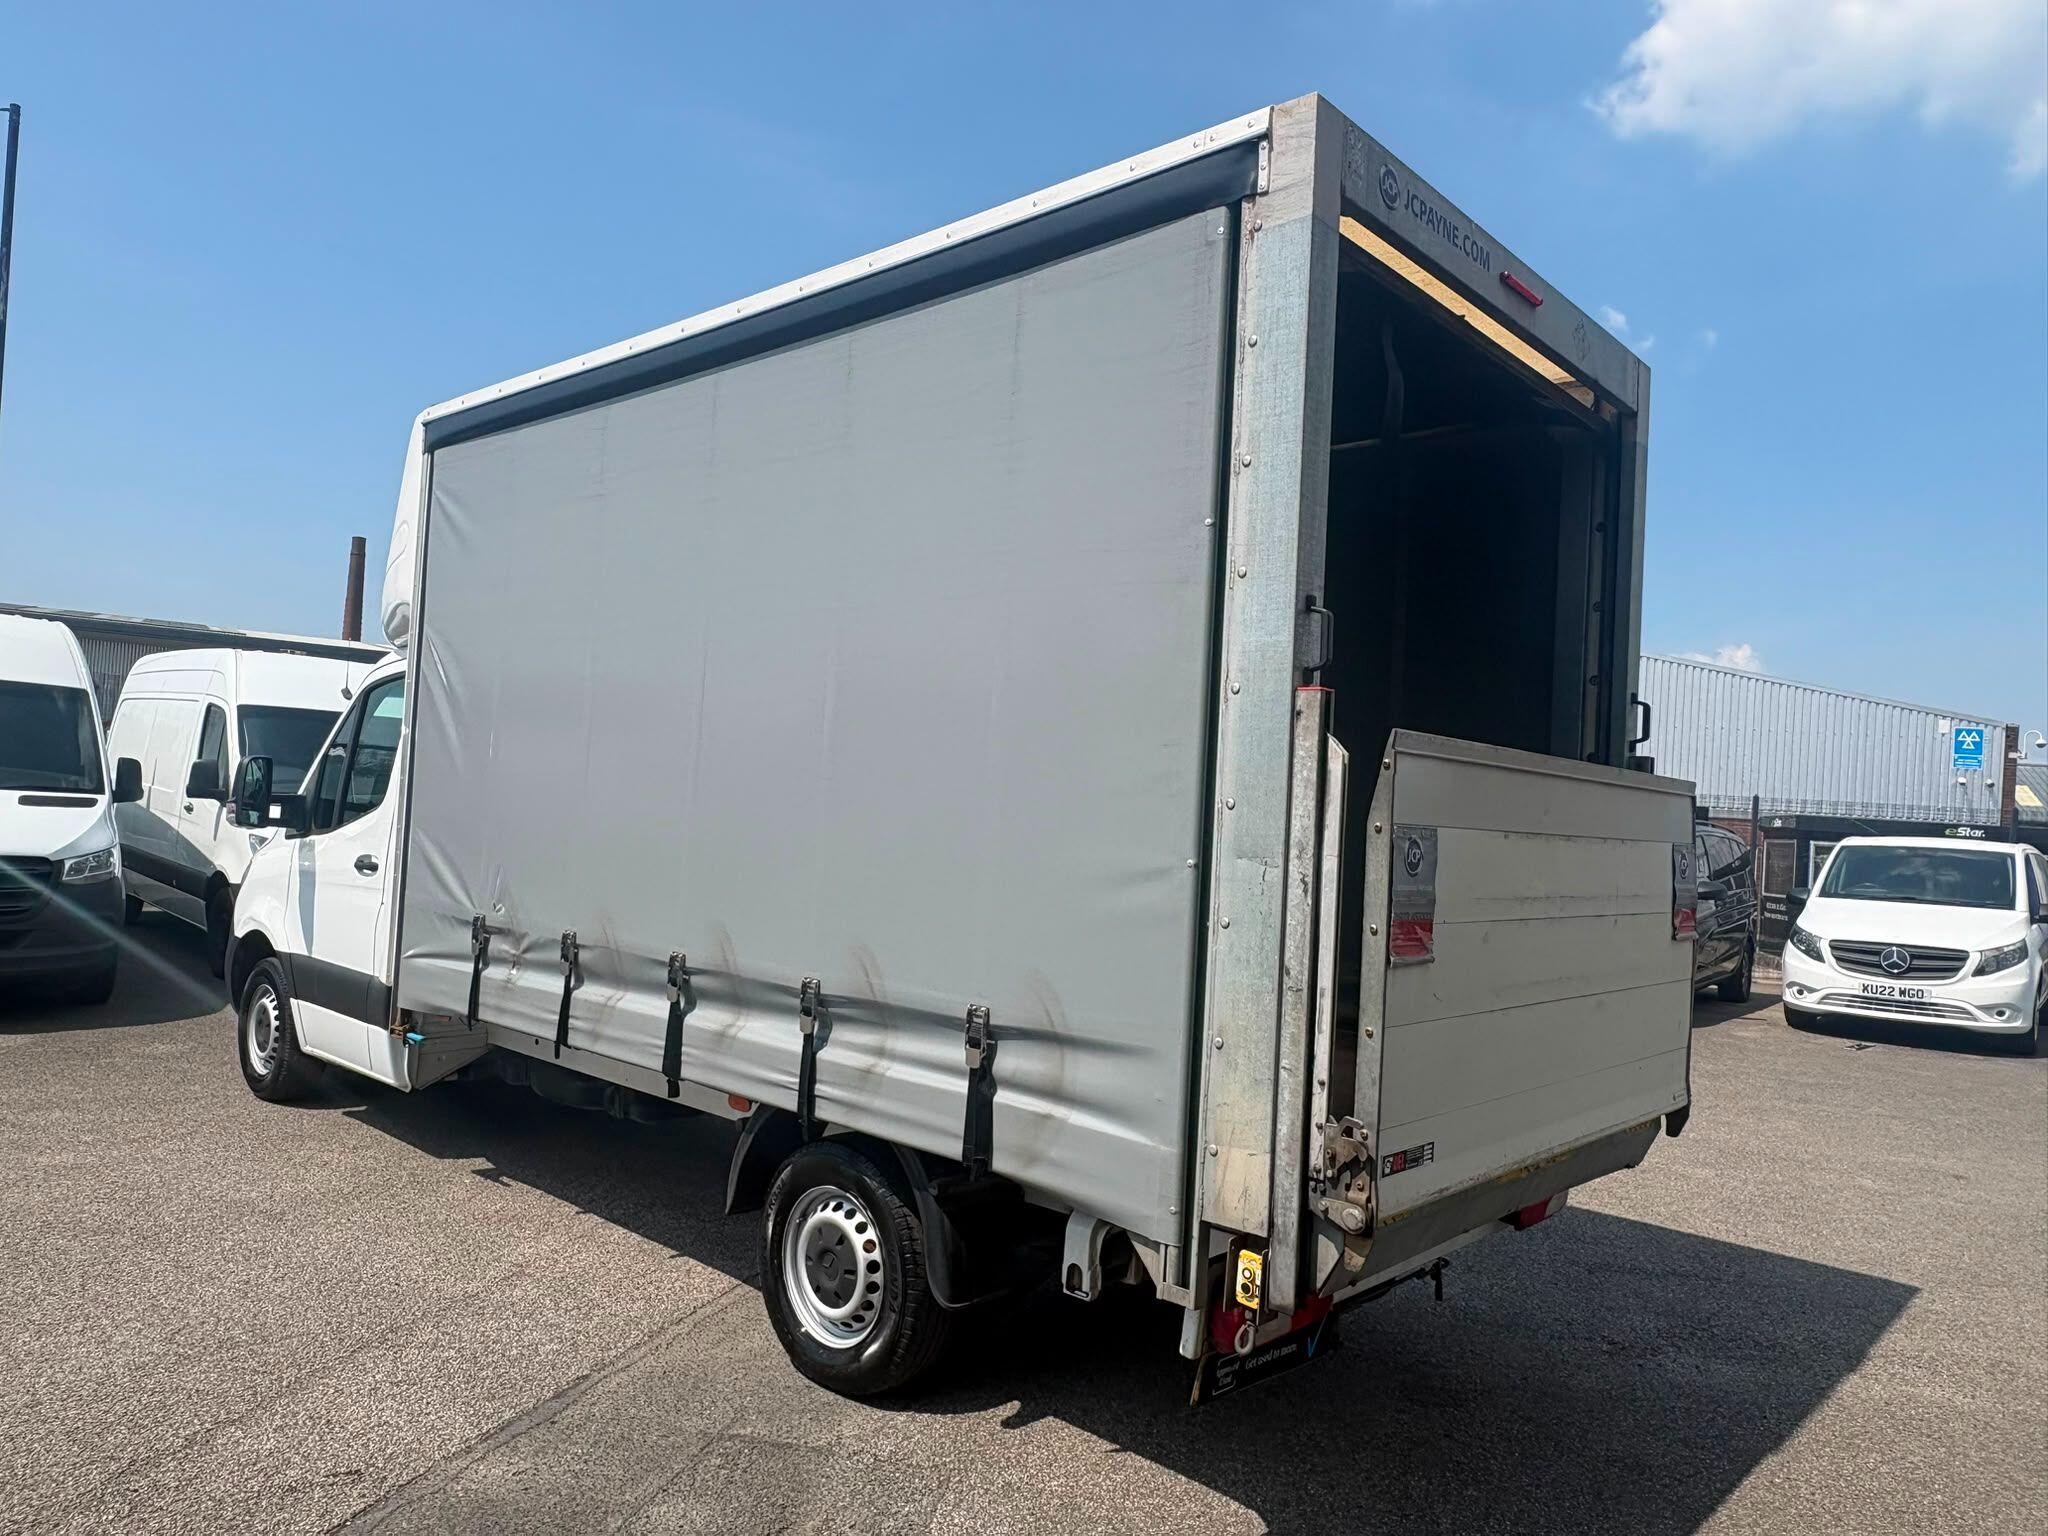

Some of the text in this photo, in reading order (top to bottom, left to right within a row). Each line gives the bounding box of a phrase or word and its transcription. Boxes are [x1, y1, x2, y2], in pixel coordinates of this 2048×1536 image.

[1404, 189, 1490, 272] JCPAYNE.COM
[1862, 983, 1925, 999] KU22 WGO
